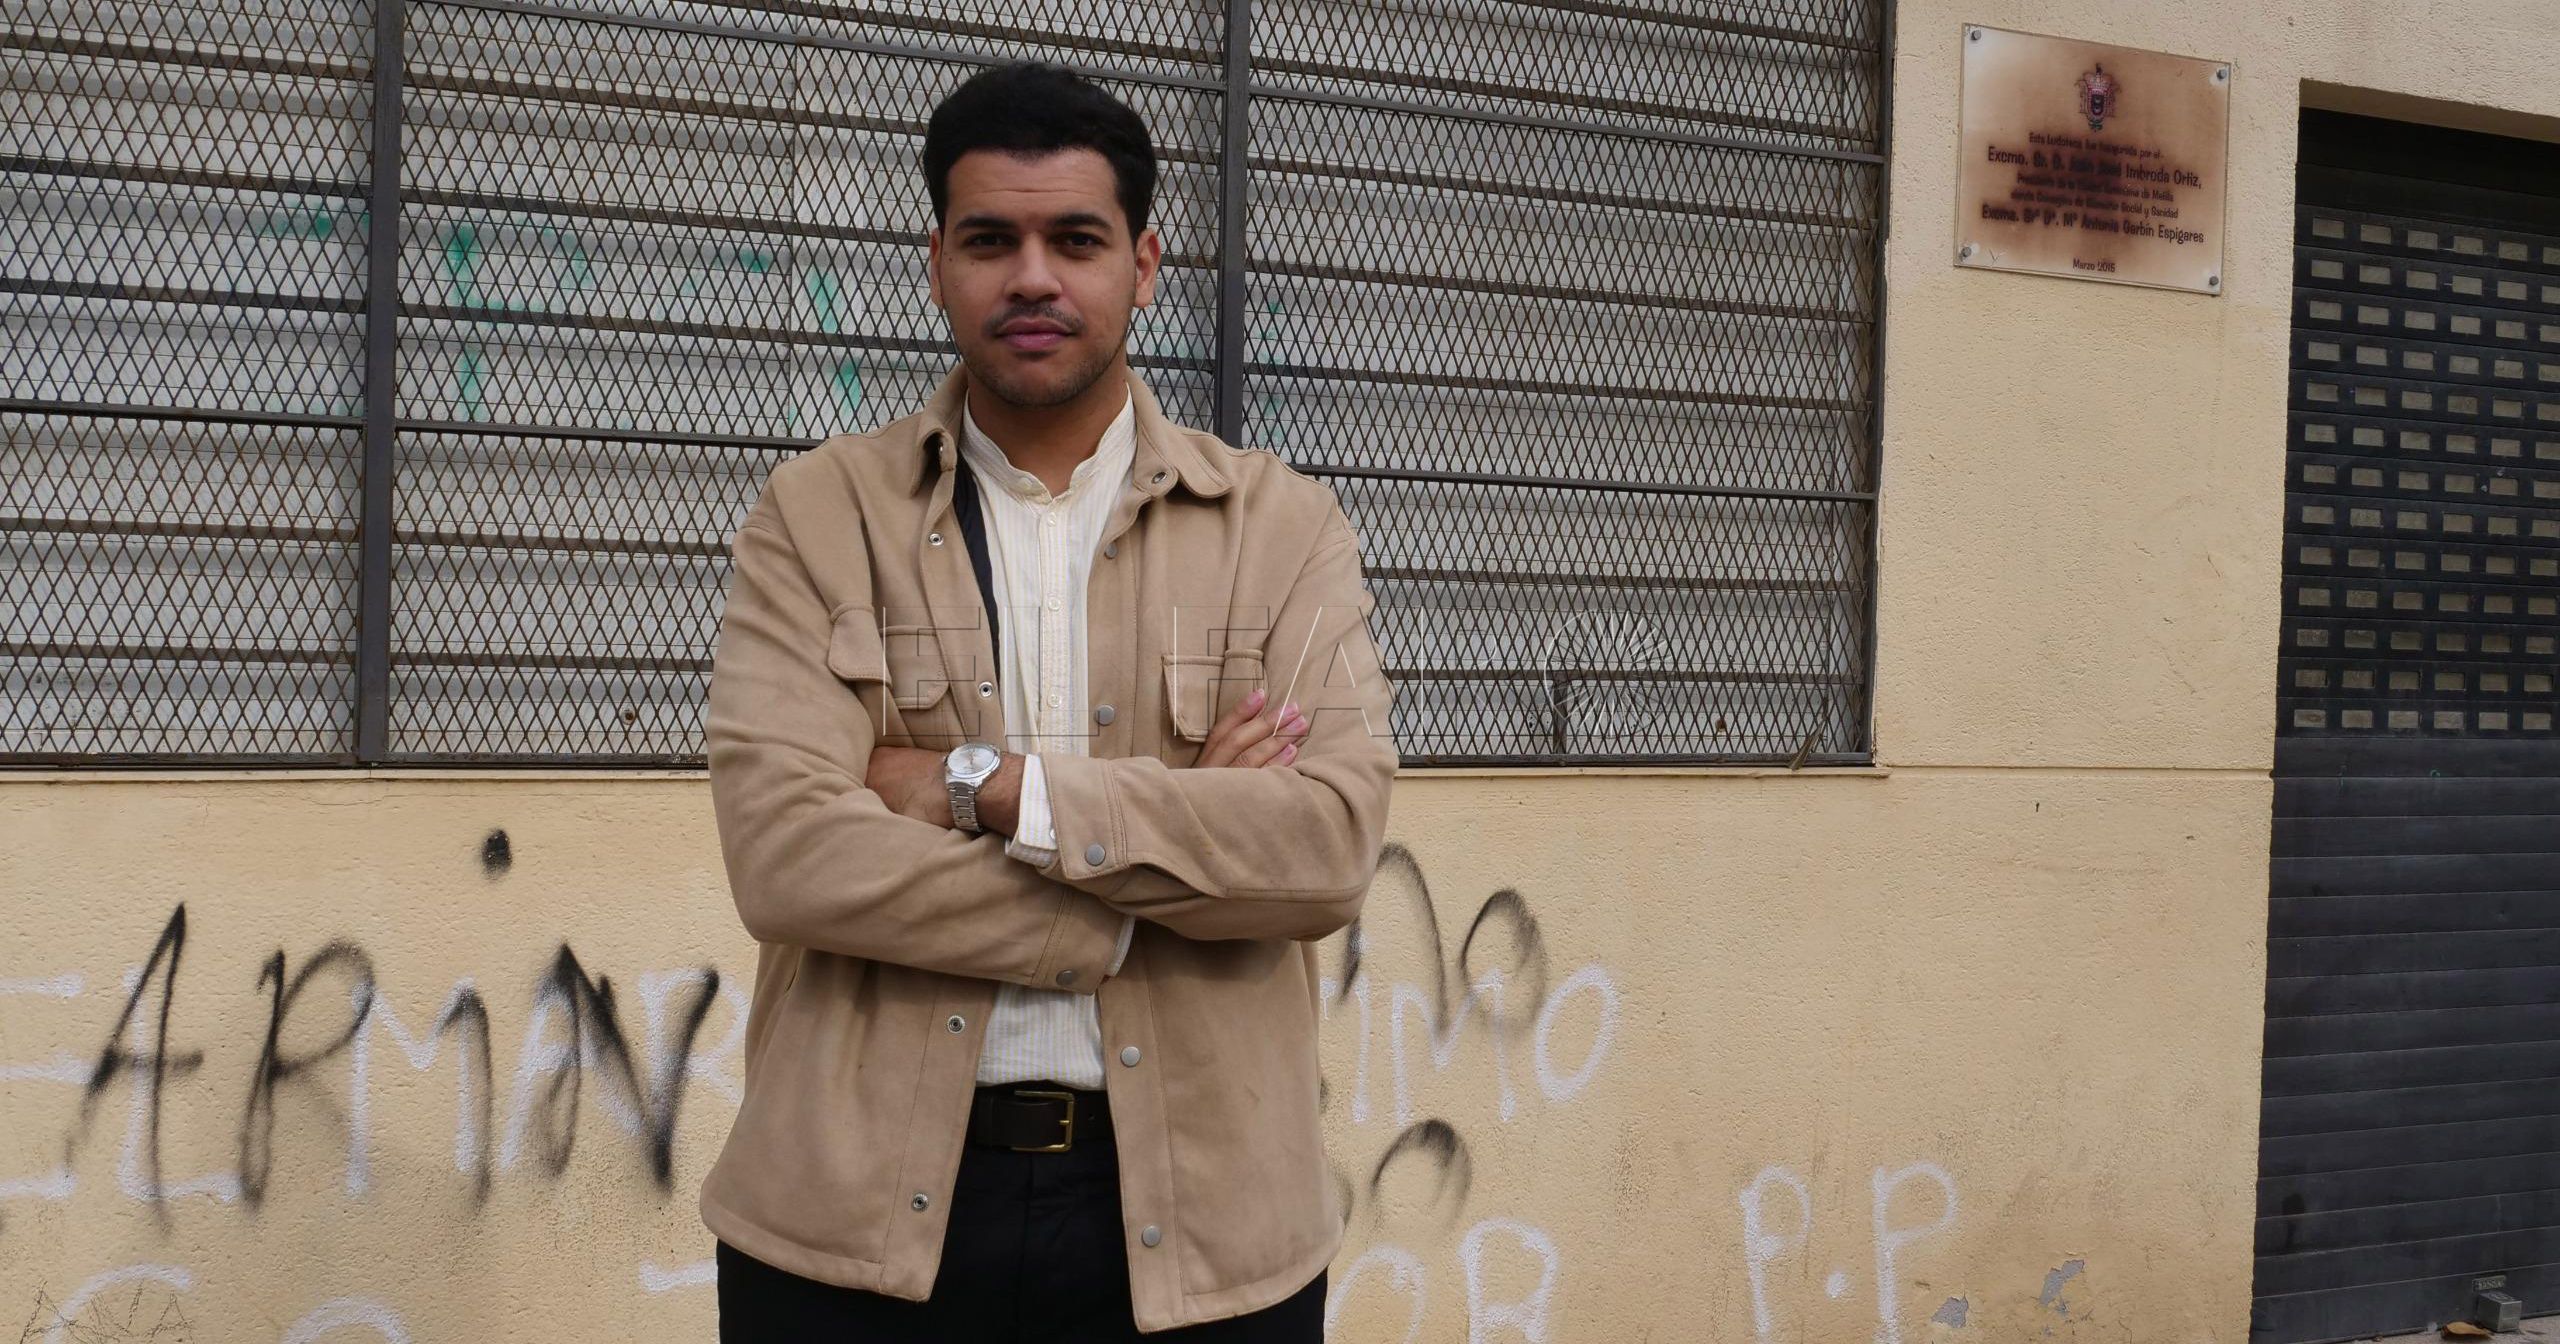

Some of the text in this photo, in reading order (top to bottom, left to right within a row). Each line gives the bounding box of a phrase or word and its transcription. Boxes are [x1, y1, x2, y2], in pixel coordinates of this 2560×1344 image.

[2139, 149, 2152, 160] por
[1988, 146, 2028, 167] Excmo.
[2126, 164, 2170, 184] Imbroda
[2173, 170, 2202, 189] Ortiz,
[2158, 224, 2204, 244] Espigares
[2073, 258, 2095, 271] Marzo
